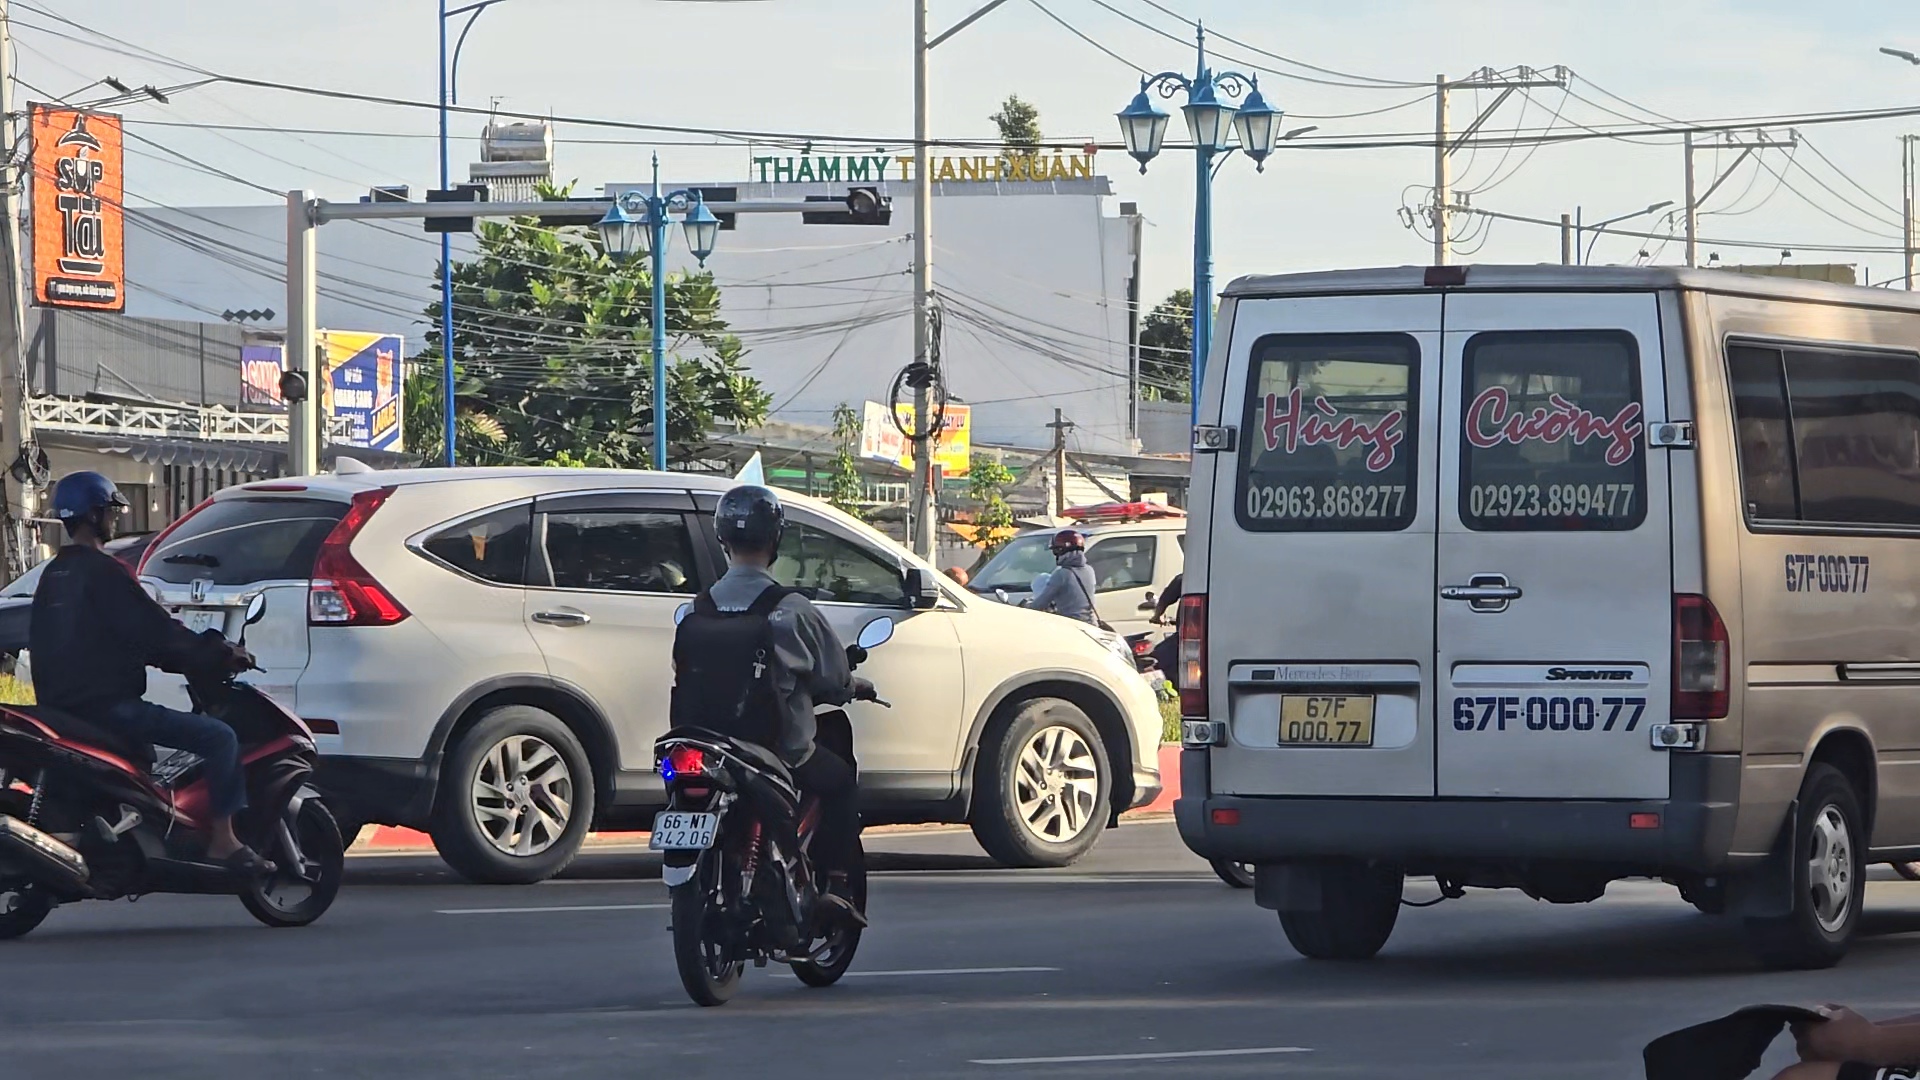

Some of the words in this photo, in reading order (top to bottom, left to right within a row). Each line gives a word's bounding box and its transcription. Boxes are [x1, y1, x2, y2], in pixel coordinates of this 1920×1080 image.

[754, 141, 841, 183] THẨM
[896, 156, 1001, 183] TANH
[1006, 148, 1091, 182] XUÂN
[1262, 387, 1404, 472] Hùng
[1466, 386, 1643, 466] Cường
[1247, 485, 1406, 518] 02963.868277
[1470, 484, 1634, 516] 02923.899477
[1306, 697, 1346, 718] 67F
[1289, 721, 1361, 742] 000.77
[663, 814, 707, 829] 66-N1
